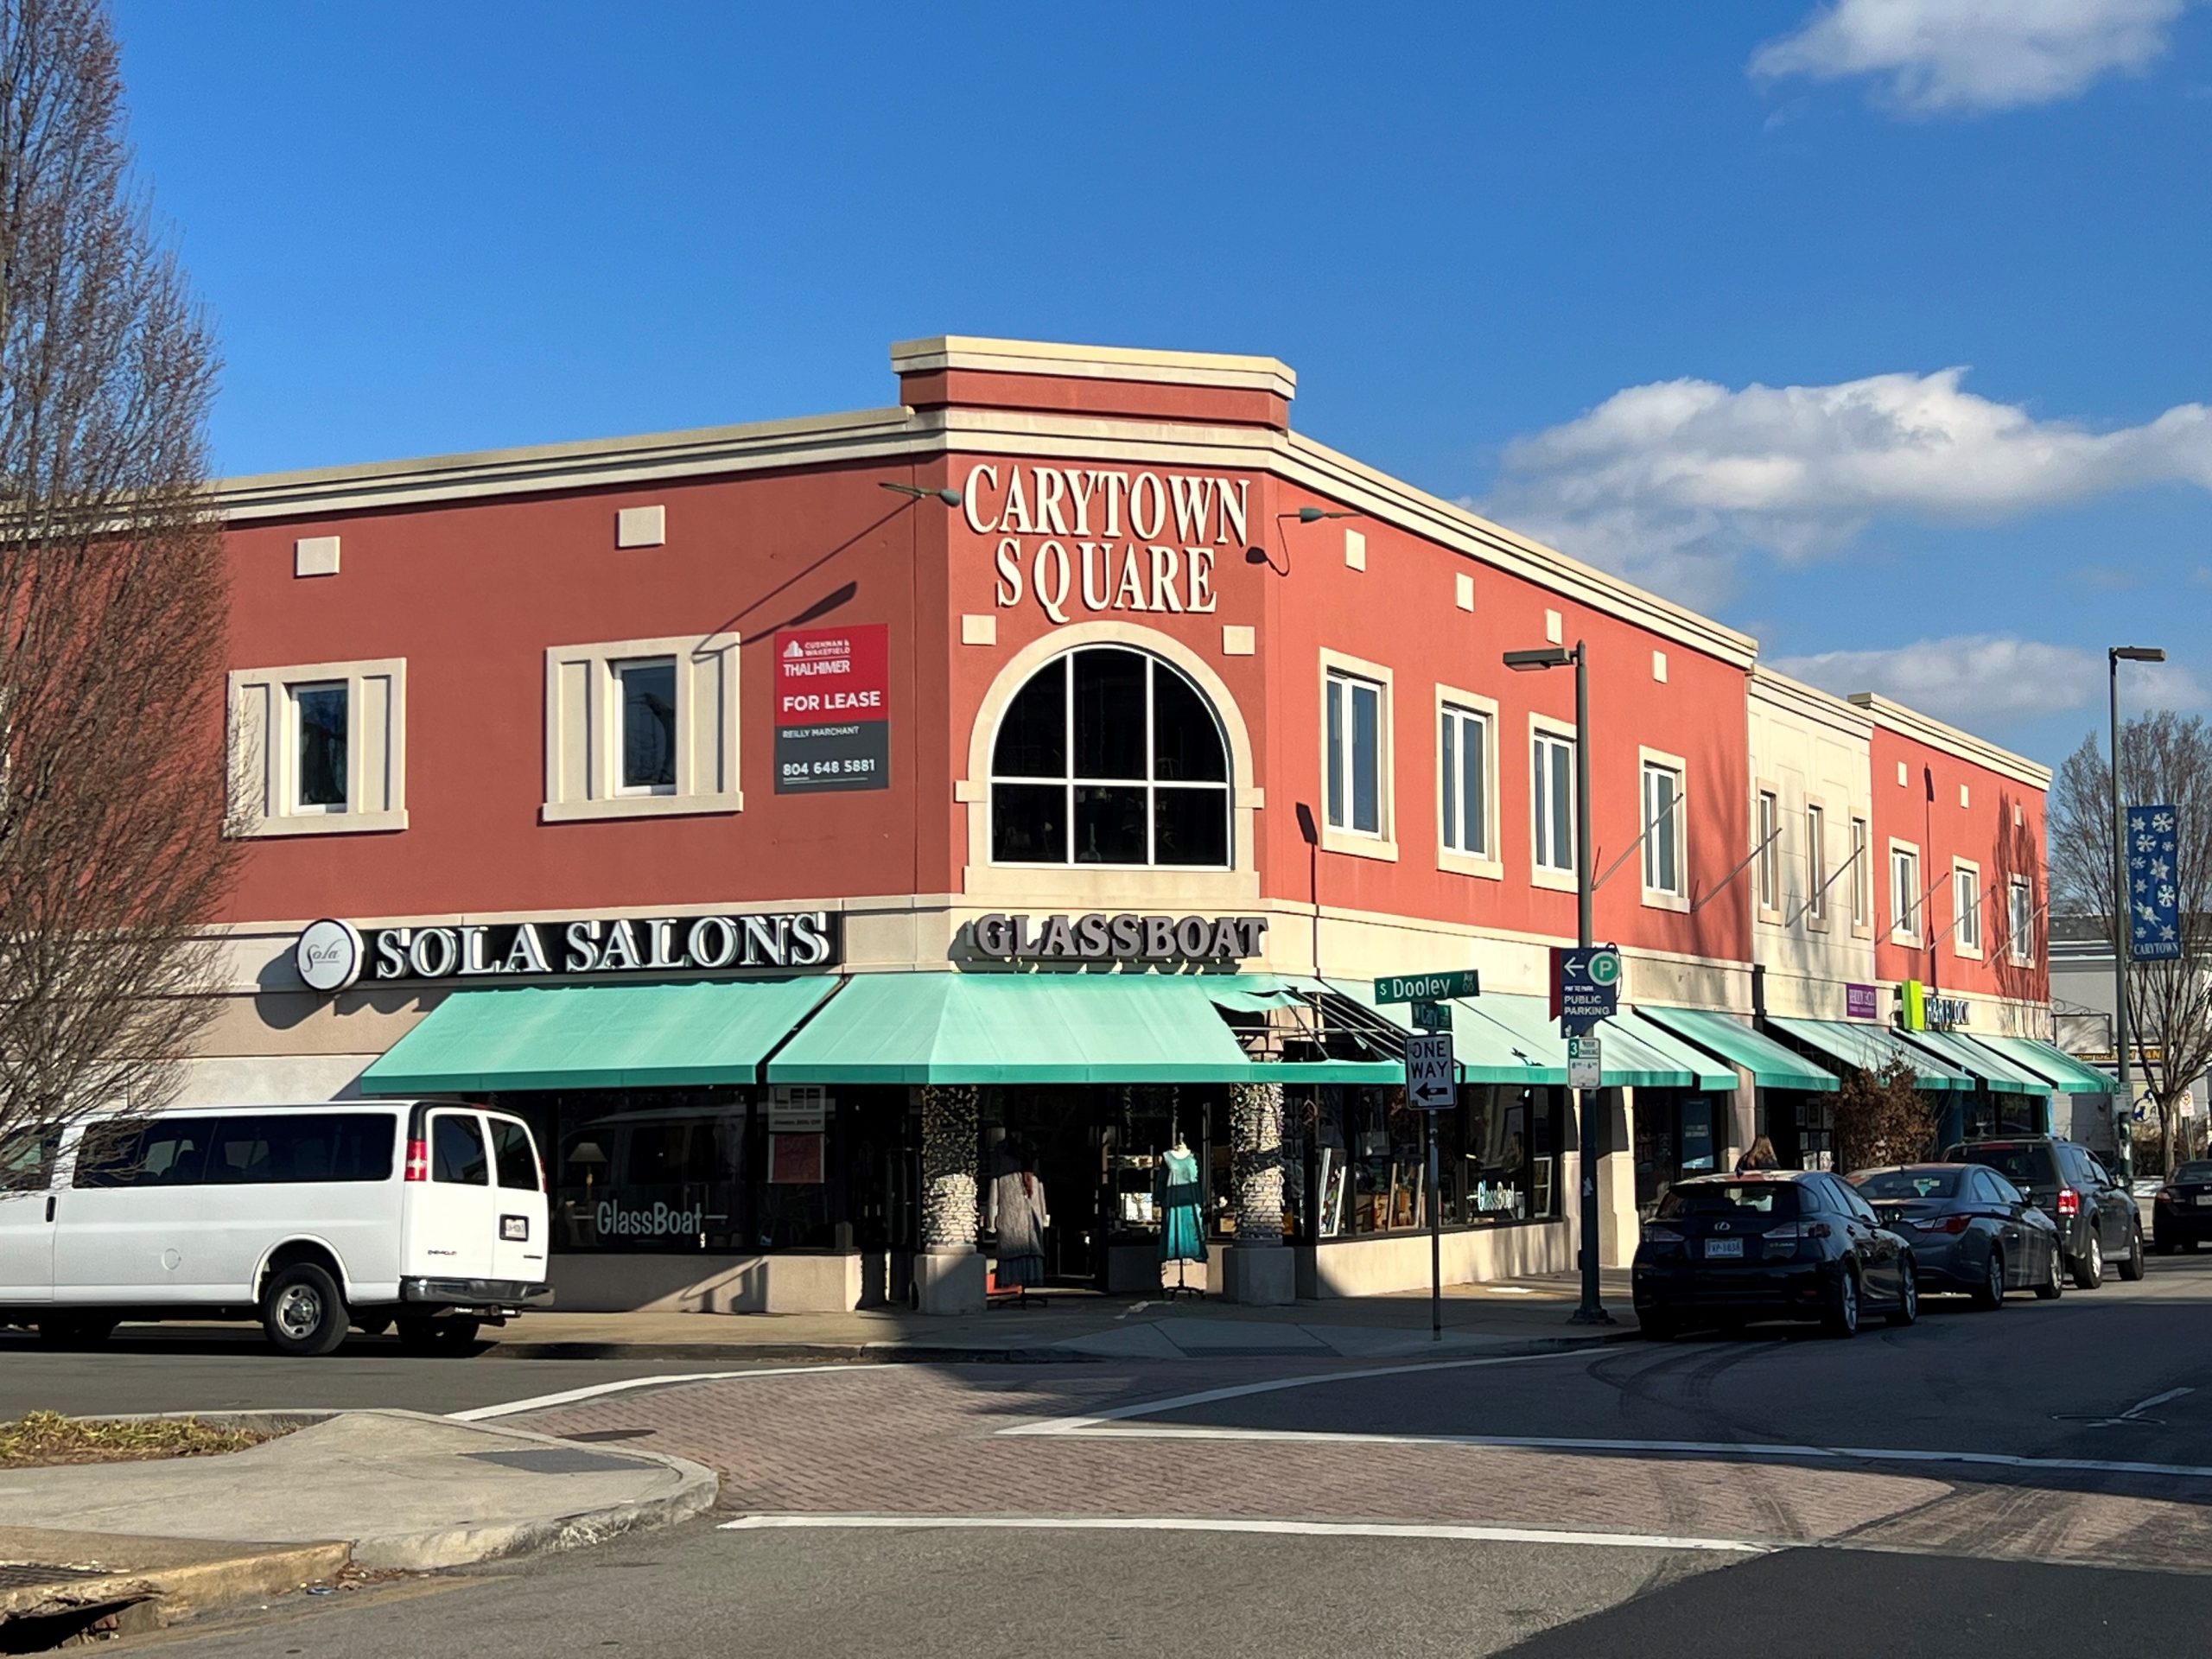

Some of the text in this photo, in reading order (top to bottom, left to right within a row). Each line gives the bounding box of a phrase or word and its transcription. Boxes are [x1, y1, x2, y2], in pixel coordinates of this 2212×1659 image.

[963, 463, 1250, 547] CARYTOWN
[995, 537, 1217, 624] SQUARE
[783, 660, 850, 677] THALHIMER
[784, 691, 881, 712] FOR LEASE
[811, 726, 860, 737] MARCHANT
[783, 759, 875, 776] 804 648 5881
[976, 913, 1268, 957] GLASSBOAT
[377, 912, 830, 978] SOLA SALONS
[2133, 942, 2178, 955] CARYTOWN
[302, 938, 347, 973] Sola
[1379, 983, 1387, 995] S
[1393, 976, 1451, 998] Dooley
[1564, 995, 1602, 1004] PUBLIC
[1564, 1007, 1611, 1015] PARKING
[1411, 1041, 1446, 1058] ONE
[1570, 1042, 1578, 1055] 3
[1410, 1061, 1448, 1078] WAY
[597, 1199, 702, 1235] GlassBoat
